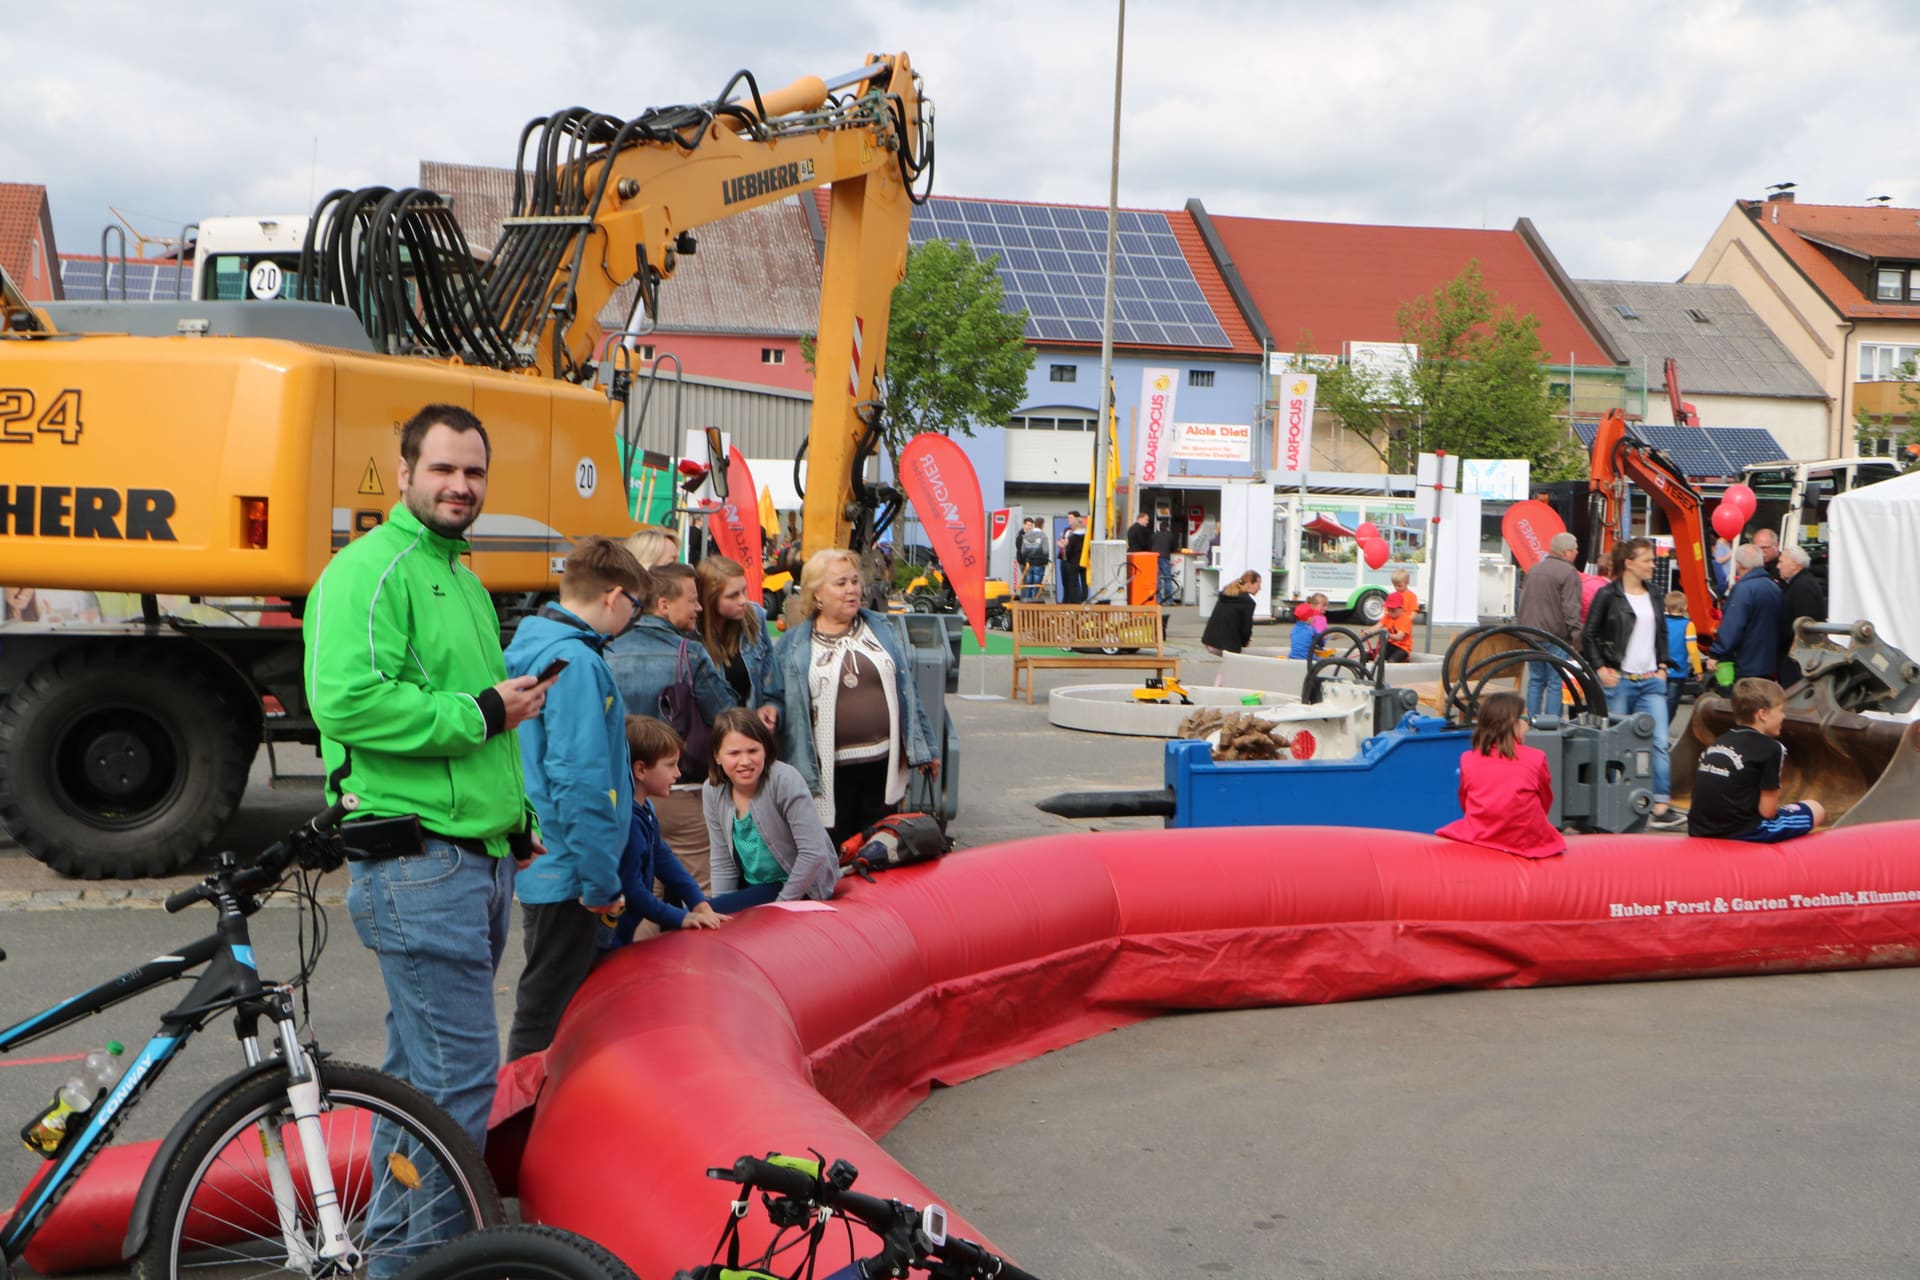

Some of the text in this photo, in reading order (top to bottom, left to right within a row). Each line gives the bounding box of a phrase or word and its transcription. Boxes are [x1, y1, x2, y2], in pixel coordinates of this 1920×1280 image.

[722, 161, 800, 206] LIEBHERR
[256, 268, 276, 291] 20
[1143, 394, 1165, 482] SOLARFOCUS
[579, 463, 594, 489] 20
[1610, 903, 1661, 918] Huber
[1665, 900, 1711, 914] Forst
[1712, 897, 1729, 913] &
[1731, 896, 1788, 912] Garten
[98, 1053, 151, 1126] CONWAY
